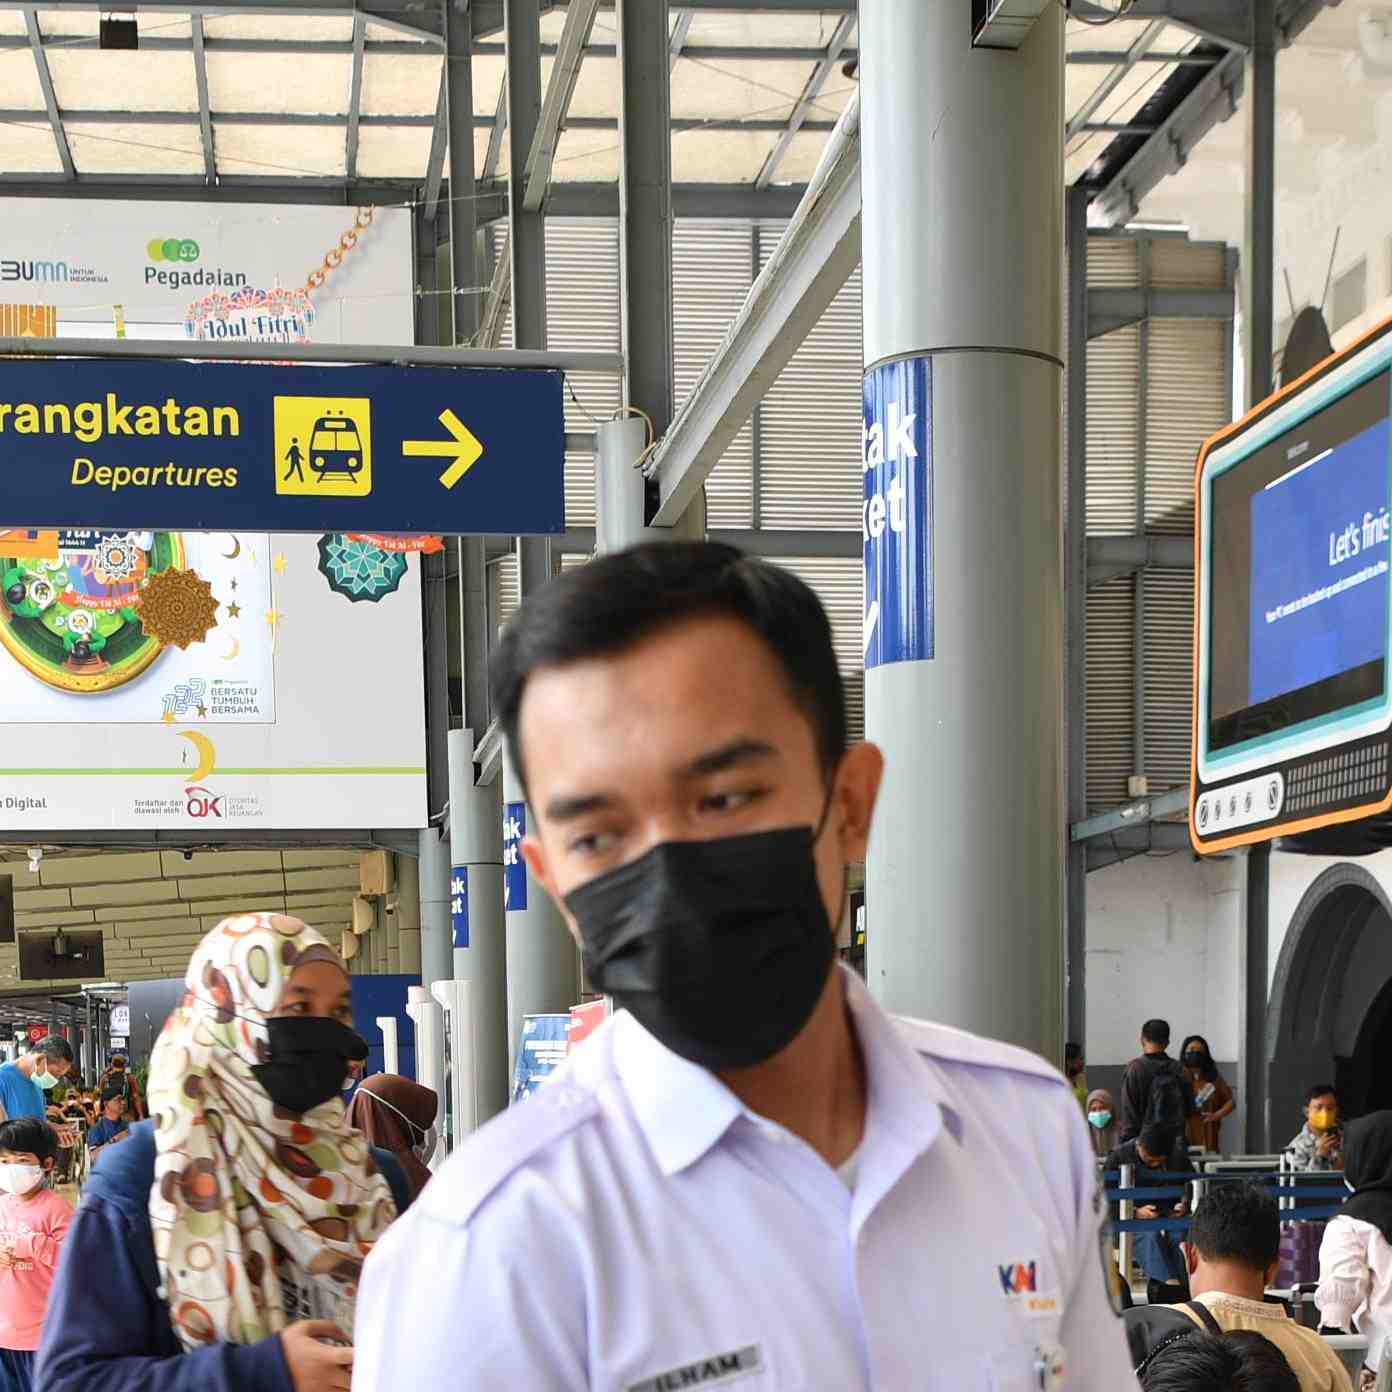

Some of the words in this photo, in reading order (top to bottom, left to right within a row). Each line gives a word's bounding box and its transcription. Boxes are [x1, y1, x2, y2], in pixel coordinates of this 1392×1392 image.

[144, 266, 247, 290] Pegadaian
[203, 317, 248, 339] Idul
[251, 314, 299, 336] Fitri
[863, 400, 918, 473] ak
[70, 459, 239, 491] Departures
[1328, 521, 1360, 567] Let's
[210, 687, 257, 696] BERSATU
[212, 696, 254, 705] TUMBUH
[211, 705, 259, 714] BERSAMA
[4, 797, 48, 810] Digital
[998, 1260, 1037, 1296] KAI
